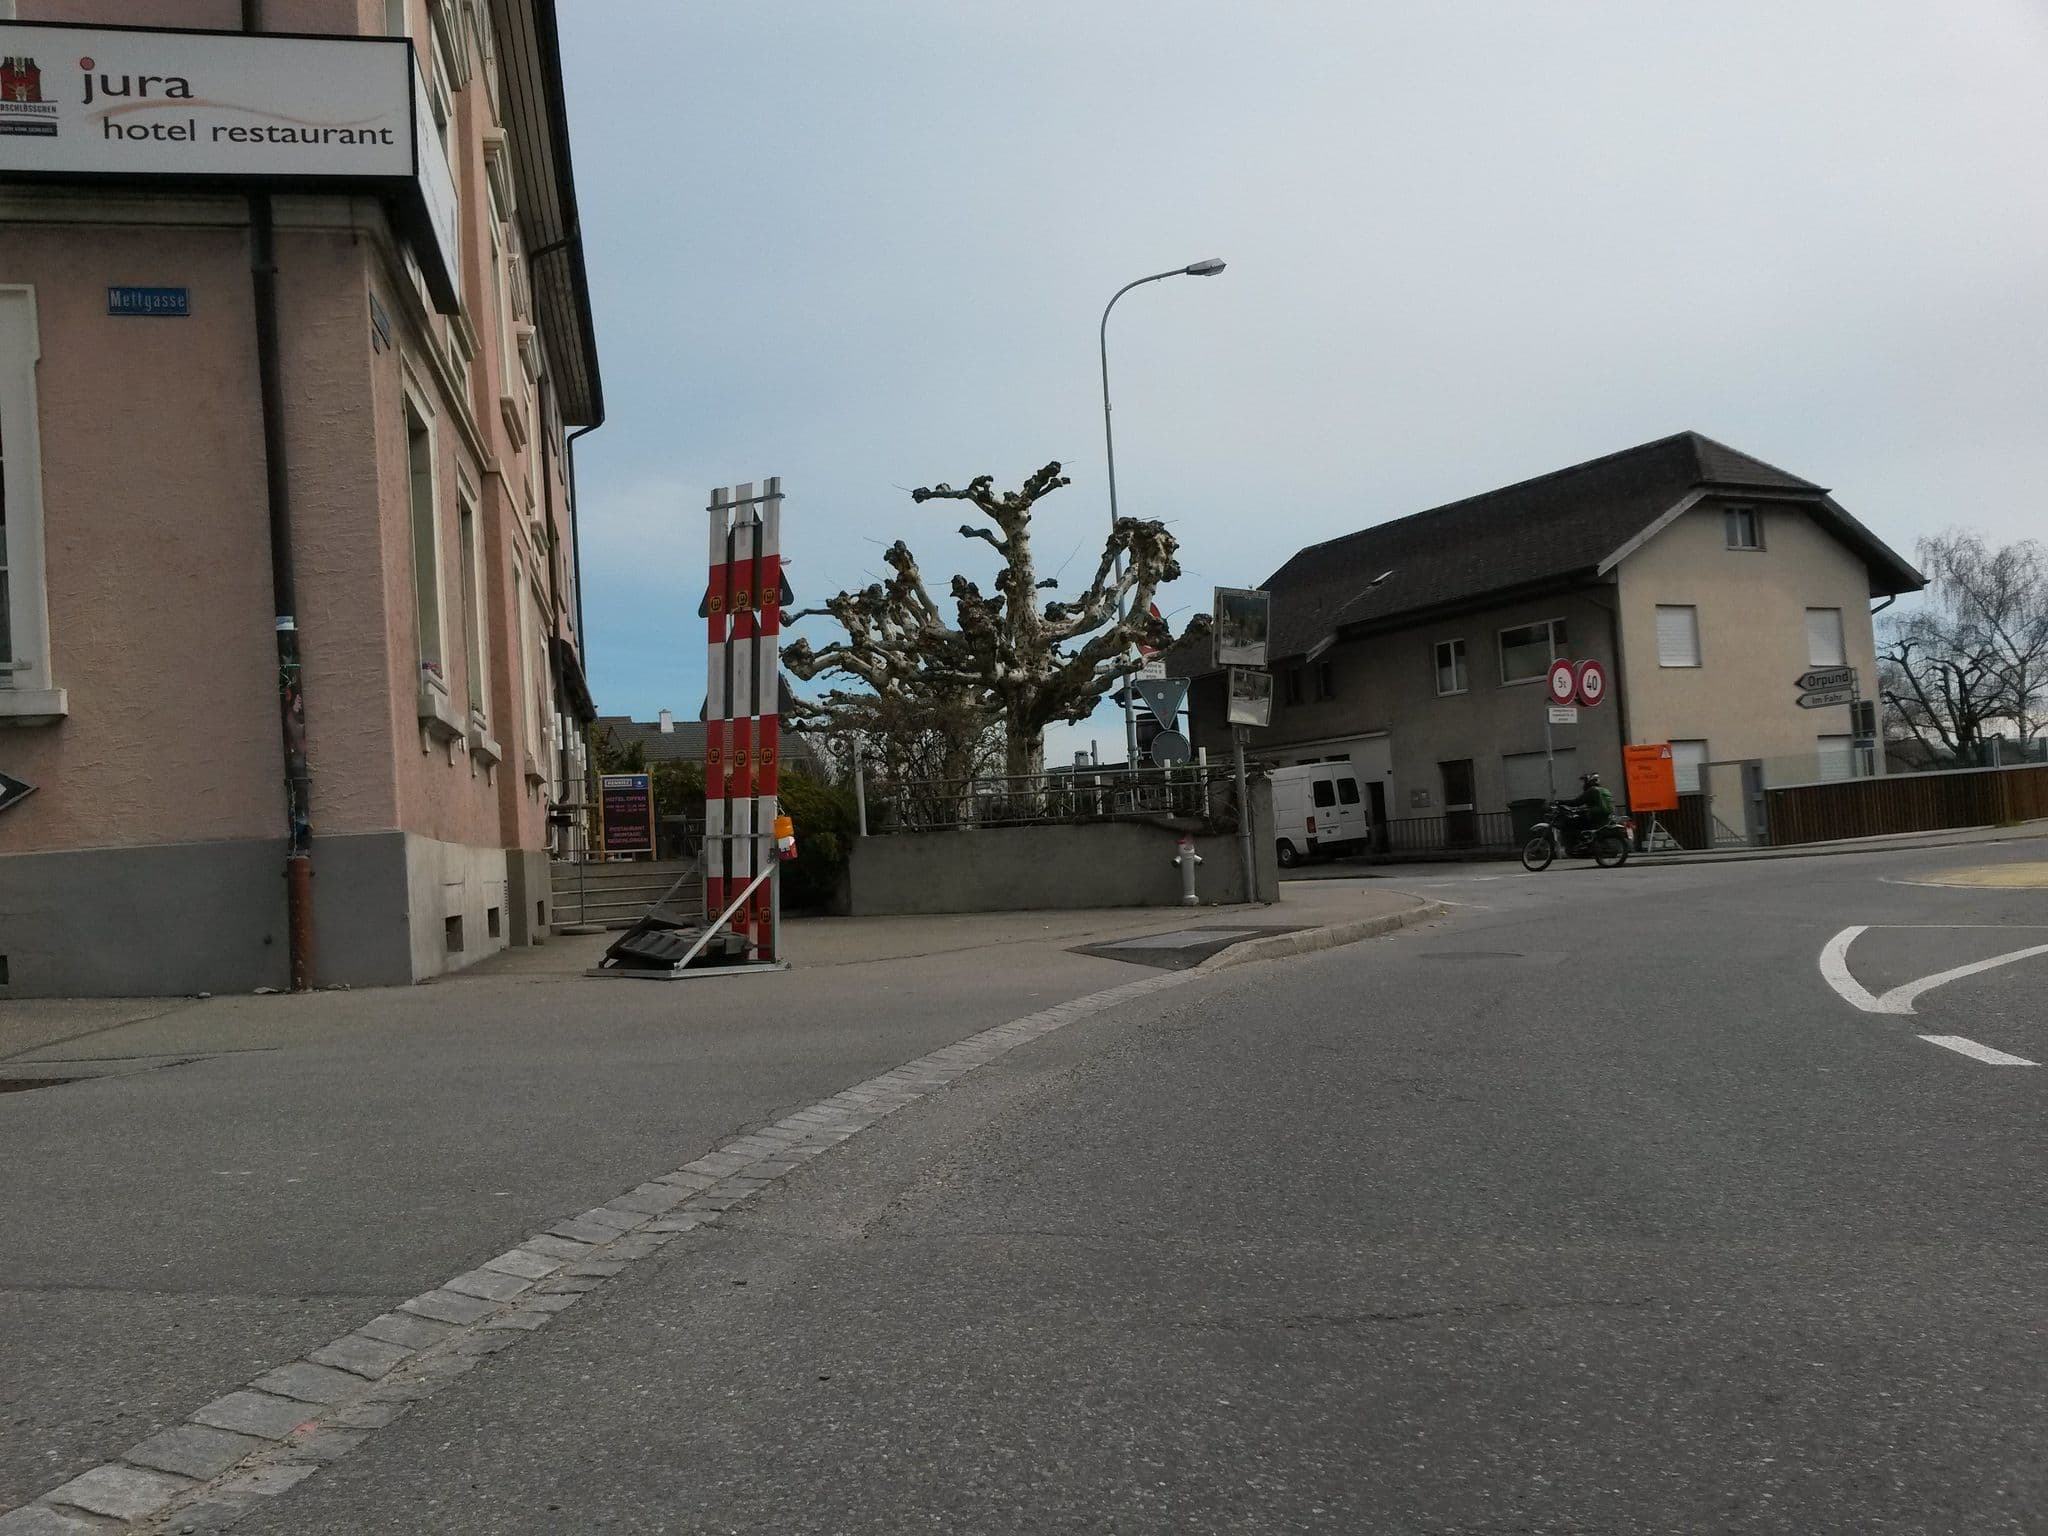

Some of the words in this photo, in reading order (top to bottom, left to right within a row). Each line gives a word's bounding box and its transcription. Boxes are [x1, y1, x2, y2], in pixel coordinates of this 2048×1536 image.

[80, 56, 194, 105] jura
[103, 116, 196, 142] hotel
[212, 123, 394, 145] restaurant
[110, 290, 185, 312] Mettgasse
[1586, 675, 1598, 691] 40
[1808, 671, 1849, 687] Orpund
